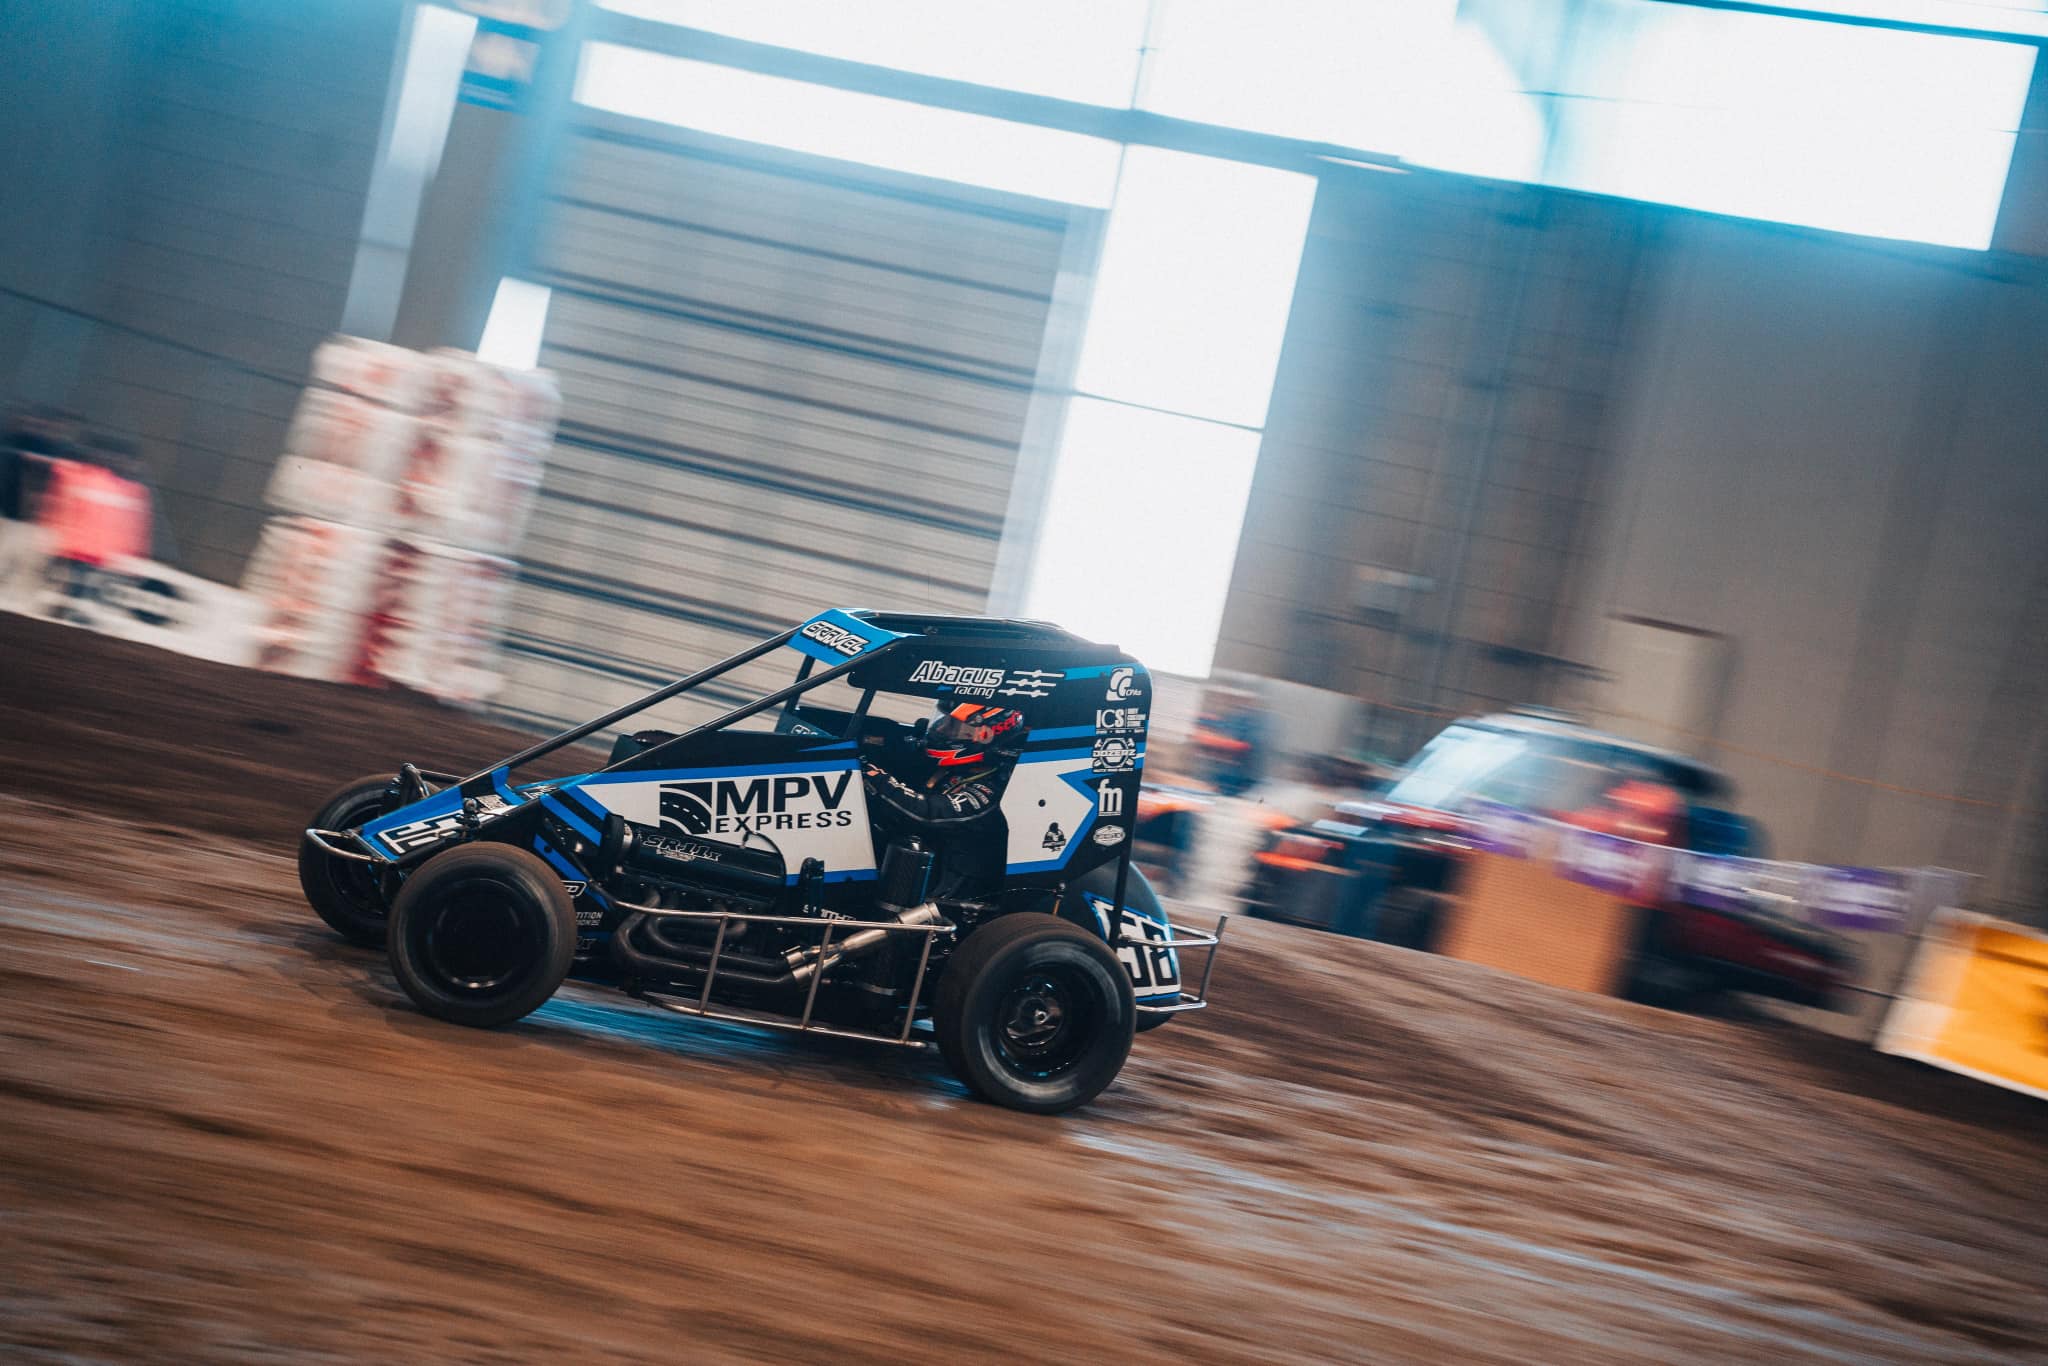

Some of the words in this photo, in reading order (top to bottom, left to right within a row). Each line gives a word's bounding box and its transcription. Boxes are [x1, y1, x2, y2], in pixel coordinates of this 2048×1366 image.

[802, 620, 869, 656] GRAVEL
[908, 660, 1006, 688] Abacus
[954, 686, 996, 699] racing
[1096, 708, 1125, 728] ICS
[717, 774, 852, 816] MPV
[715, 810, 852, 834] EXPRESS
